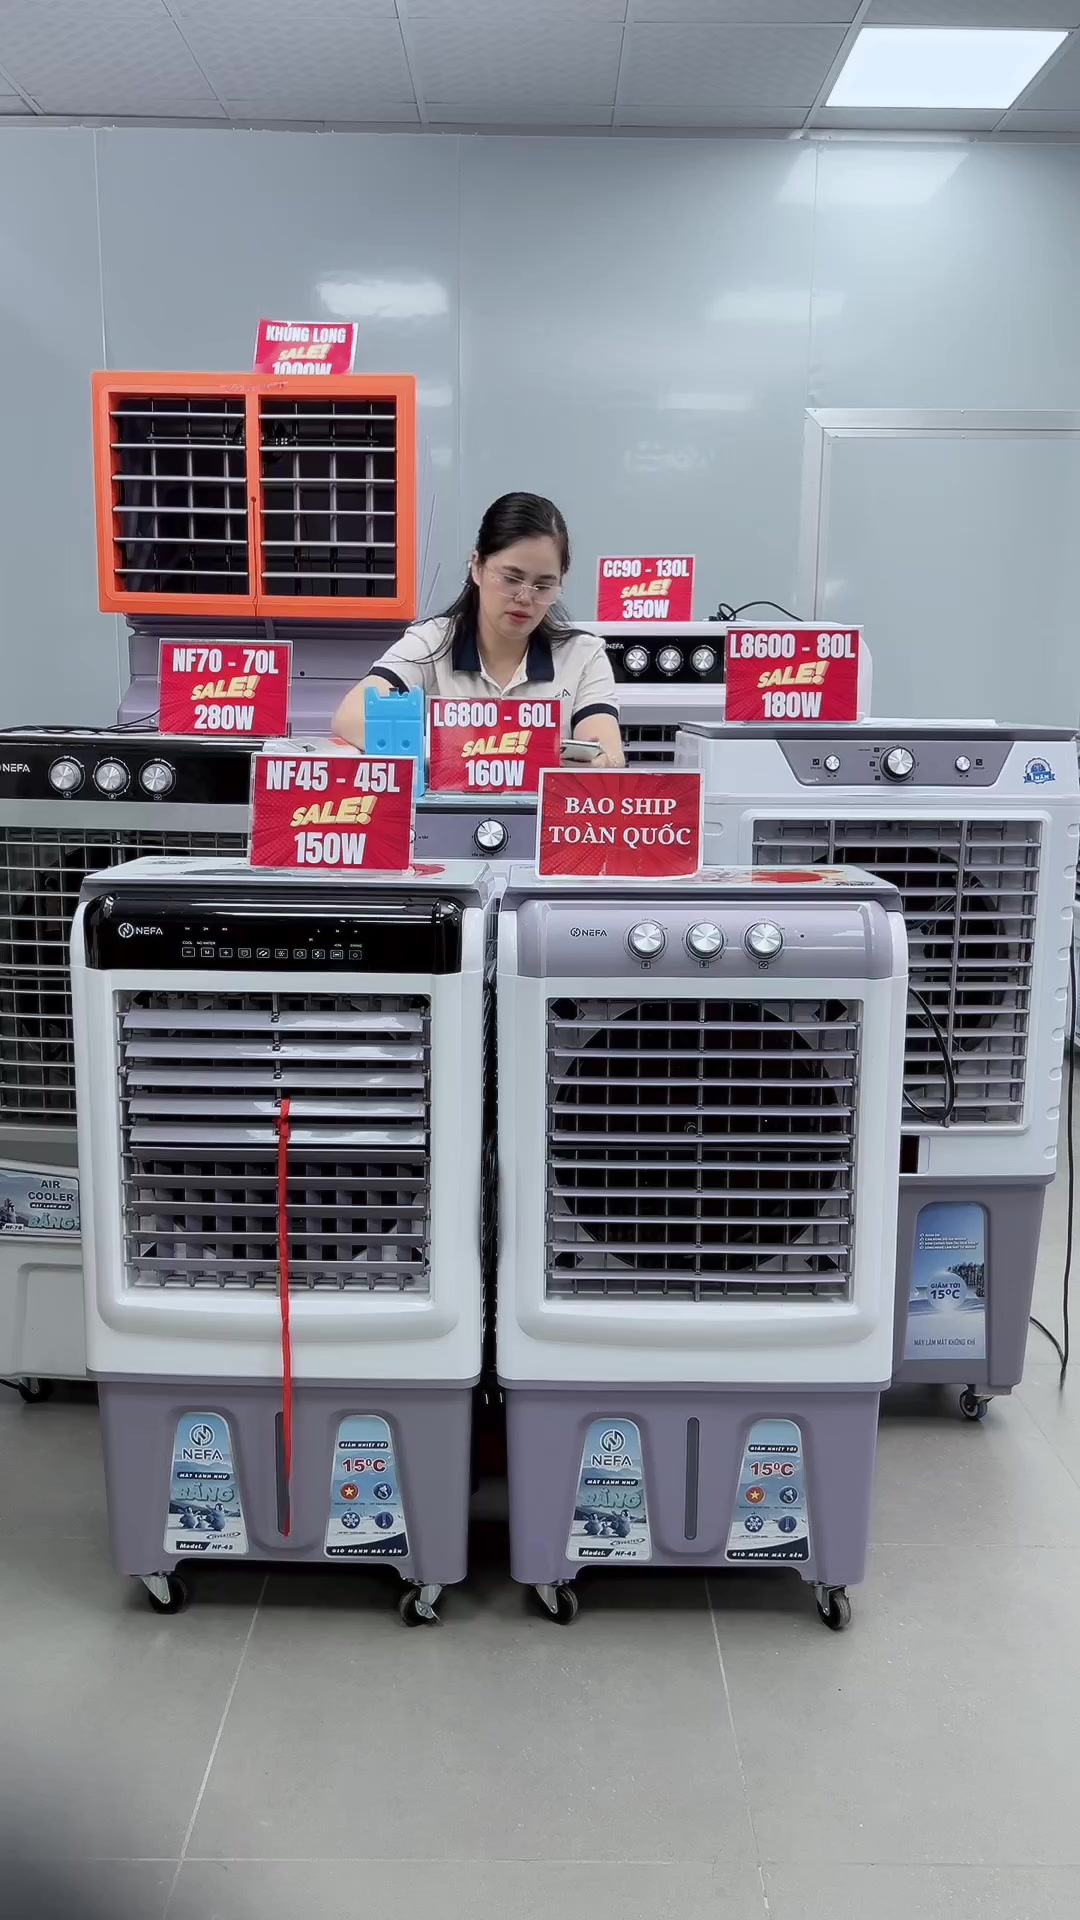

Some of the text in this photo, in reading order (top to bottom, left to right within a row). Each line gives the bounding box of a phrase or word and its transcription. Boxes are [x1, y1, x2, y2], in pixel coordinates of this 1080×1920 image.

[313, 327, 347, 344] LONG
[278, 343, 332, 361] SALE!
[272, 361, 333, 375] 1000W
[602, 559, 642, 578] CC90
[655, 559, 690, 578] 130L
[620, 578, 672, 599] SALE!
[622, 599, 670, 619] 350W
[729, 633, 796, 659] L8600
[816, 633, 856, 659] 80L
[172, 647, 223, 673] NF70
[242, 649, 279, 675] 70L
[756, 660, 830, 689] SALE!
[190, 674, 261, 701] SALE!
[433, 702, 498, 728] L6800
[518, 702, 556, 728] 60L
[761, 691, 823, 719] 180W
[193, 704, 255, 731] 280W
[460, 730, 533, 758] SALE!
[2, 763, 31, 773] NEFA
[265, 760, 329, 792] NF45
[353, 762, 401, 793] 45L
[465, 759, 525, 787] 160W
[289, 794, 378, 828] SALE!
[564, 797, 677, 815] BAO SHIP
[548, 822, 691, 849] TOÀN QUỐC
[294, 831, 367, 865] 150W
[135, 926, 164, 936] NEFA
[581, 928, 608, 938] NEFA
[41, 1180, 60, 1189] AIR
[28, 1191, 74, 1201] COOLER
[182, 1448, 223, 1460] NEFA
[591, 1454, 632, 1467] NEFA
